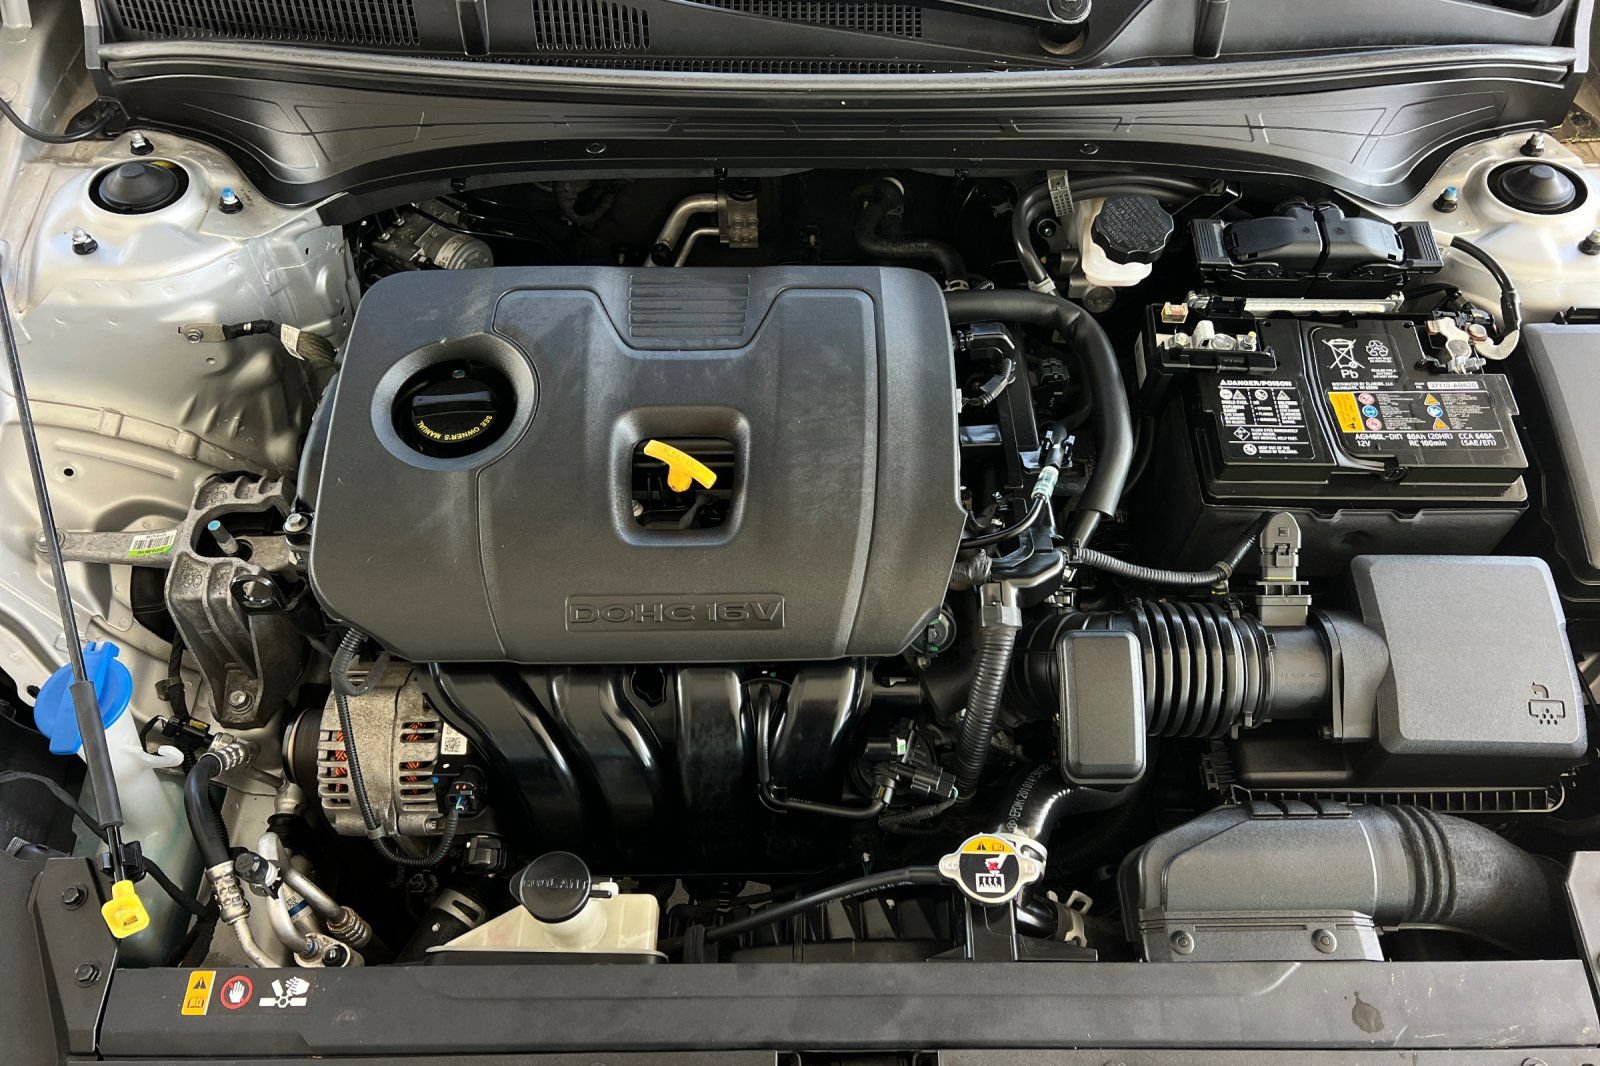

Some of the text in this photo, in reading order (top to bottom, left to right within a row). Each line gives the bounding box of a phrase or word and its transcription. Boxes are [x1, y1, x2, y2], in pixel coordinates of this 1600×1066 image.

[1341, 370, 1358, 378] Pb
[417, 415, 493, 441] SEE OWNER'S MANUAL
[569, 602, 781, 624] DOHC 16V
